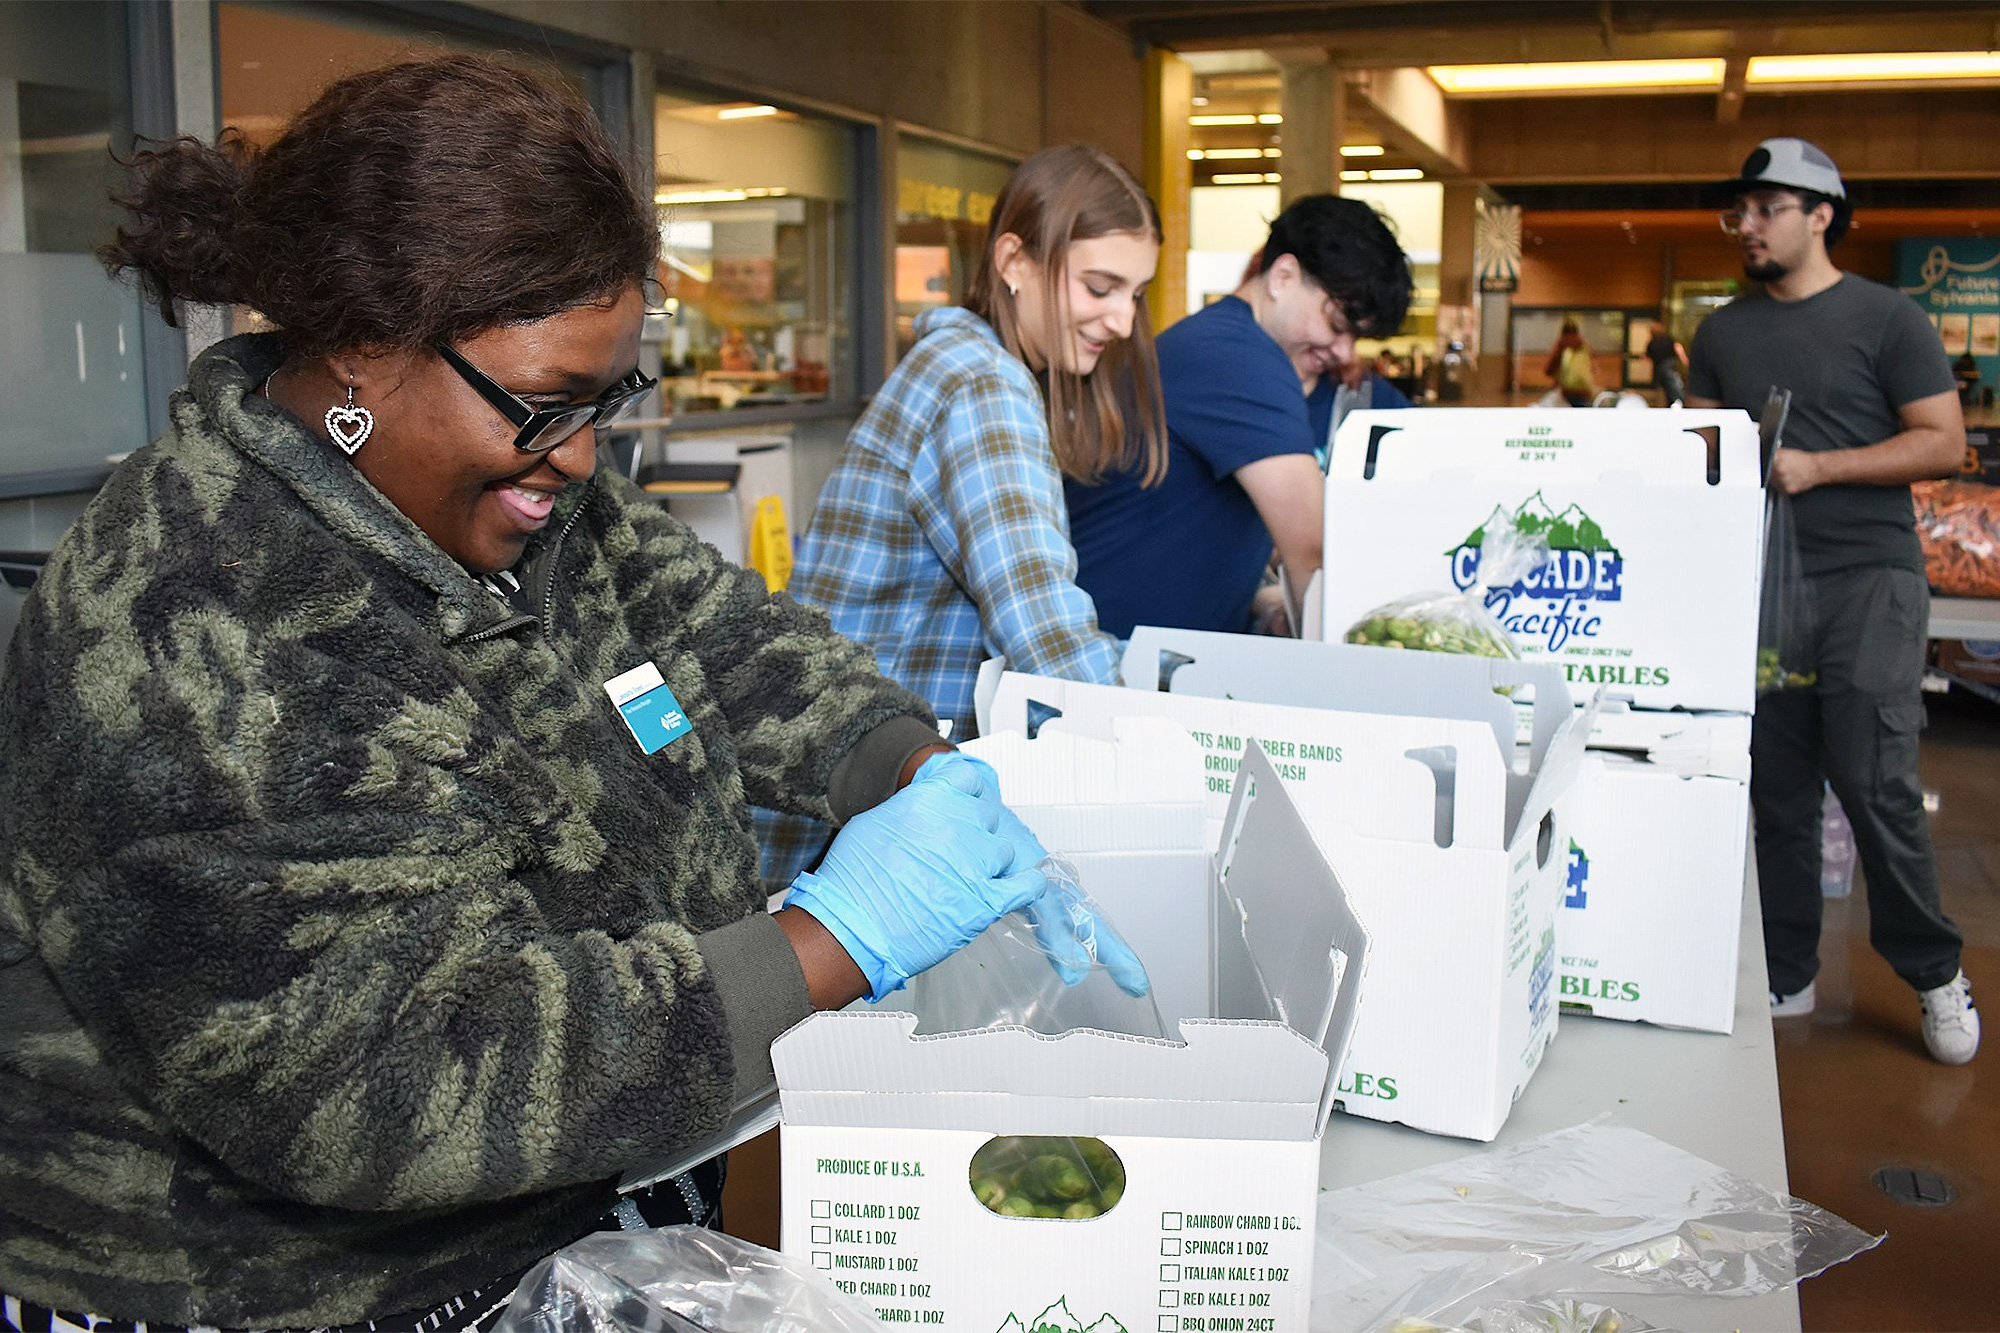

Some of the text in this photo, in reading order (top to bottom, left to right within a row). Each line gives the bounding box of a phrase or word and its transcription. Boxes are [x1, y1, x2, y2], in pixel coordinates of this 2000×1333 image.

[1946, 275, 1999, 292] Future
[1930, 289, 1999, 309] Sylvania
[1563, 664, 1670, 686] TABLES
[1217, 735, 1241, 751] AND
[1300, 744, 1343, 763] BANDS
[1560, 974, 1641, 1002] BLES
[1338, 1072, 1398, 1100] LES
[817, 1158, 870, 1175] PRODUCE
[874, 1160, 888, 1176] OF
[835, 1203, 920, 1220] COLLARD 1 DOZ
[1186, 1214, 1234, 1229] RAINBOW
[1237, 1215, 1271, 1230] CHARD
[1273, 1216, 1279, 1230] 1
[835, 1229, 897, 1245] KALE 1 DOZ
[1185, 1240, 1269, 1255] SPINACH 1 DOZ
[835, 1255, 918, 1272] MUSTARD 1 DOZ
[1184, 1266, 1290, 1282] ITALIAN KALE 1 DOZ
[836, 1280, 931, 1298] RED CHARD 1 DOZ
[1183, 1292, 1271, 1307] RED KALE 1 DOZ
[915, 1310, 921, 1323] 1
[923, 1311, 945, 1325] DOZ
[1182, 1317, 1275, 1332] BBQ ONION 24CT
